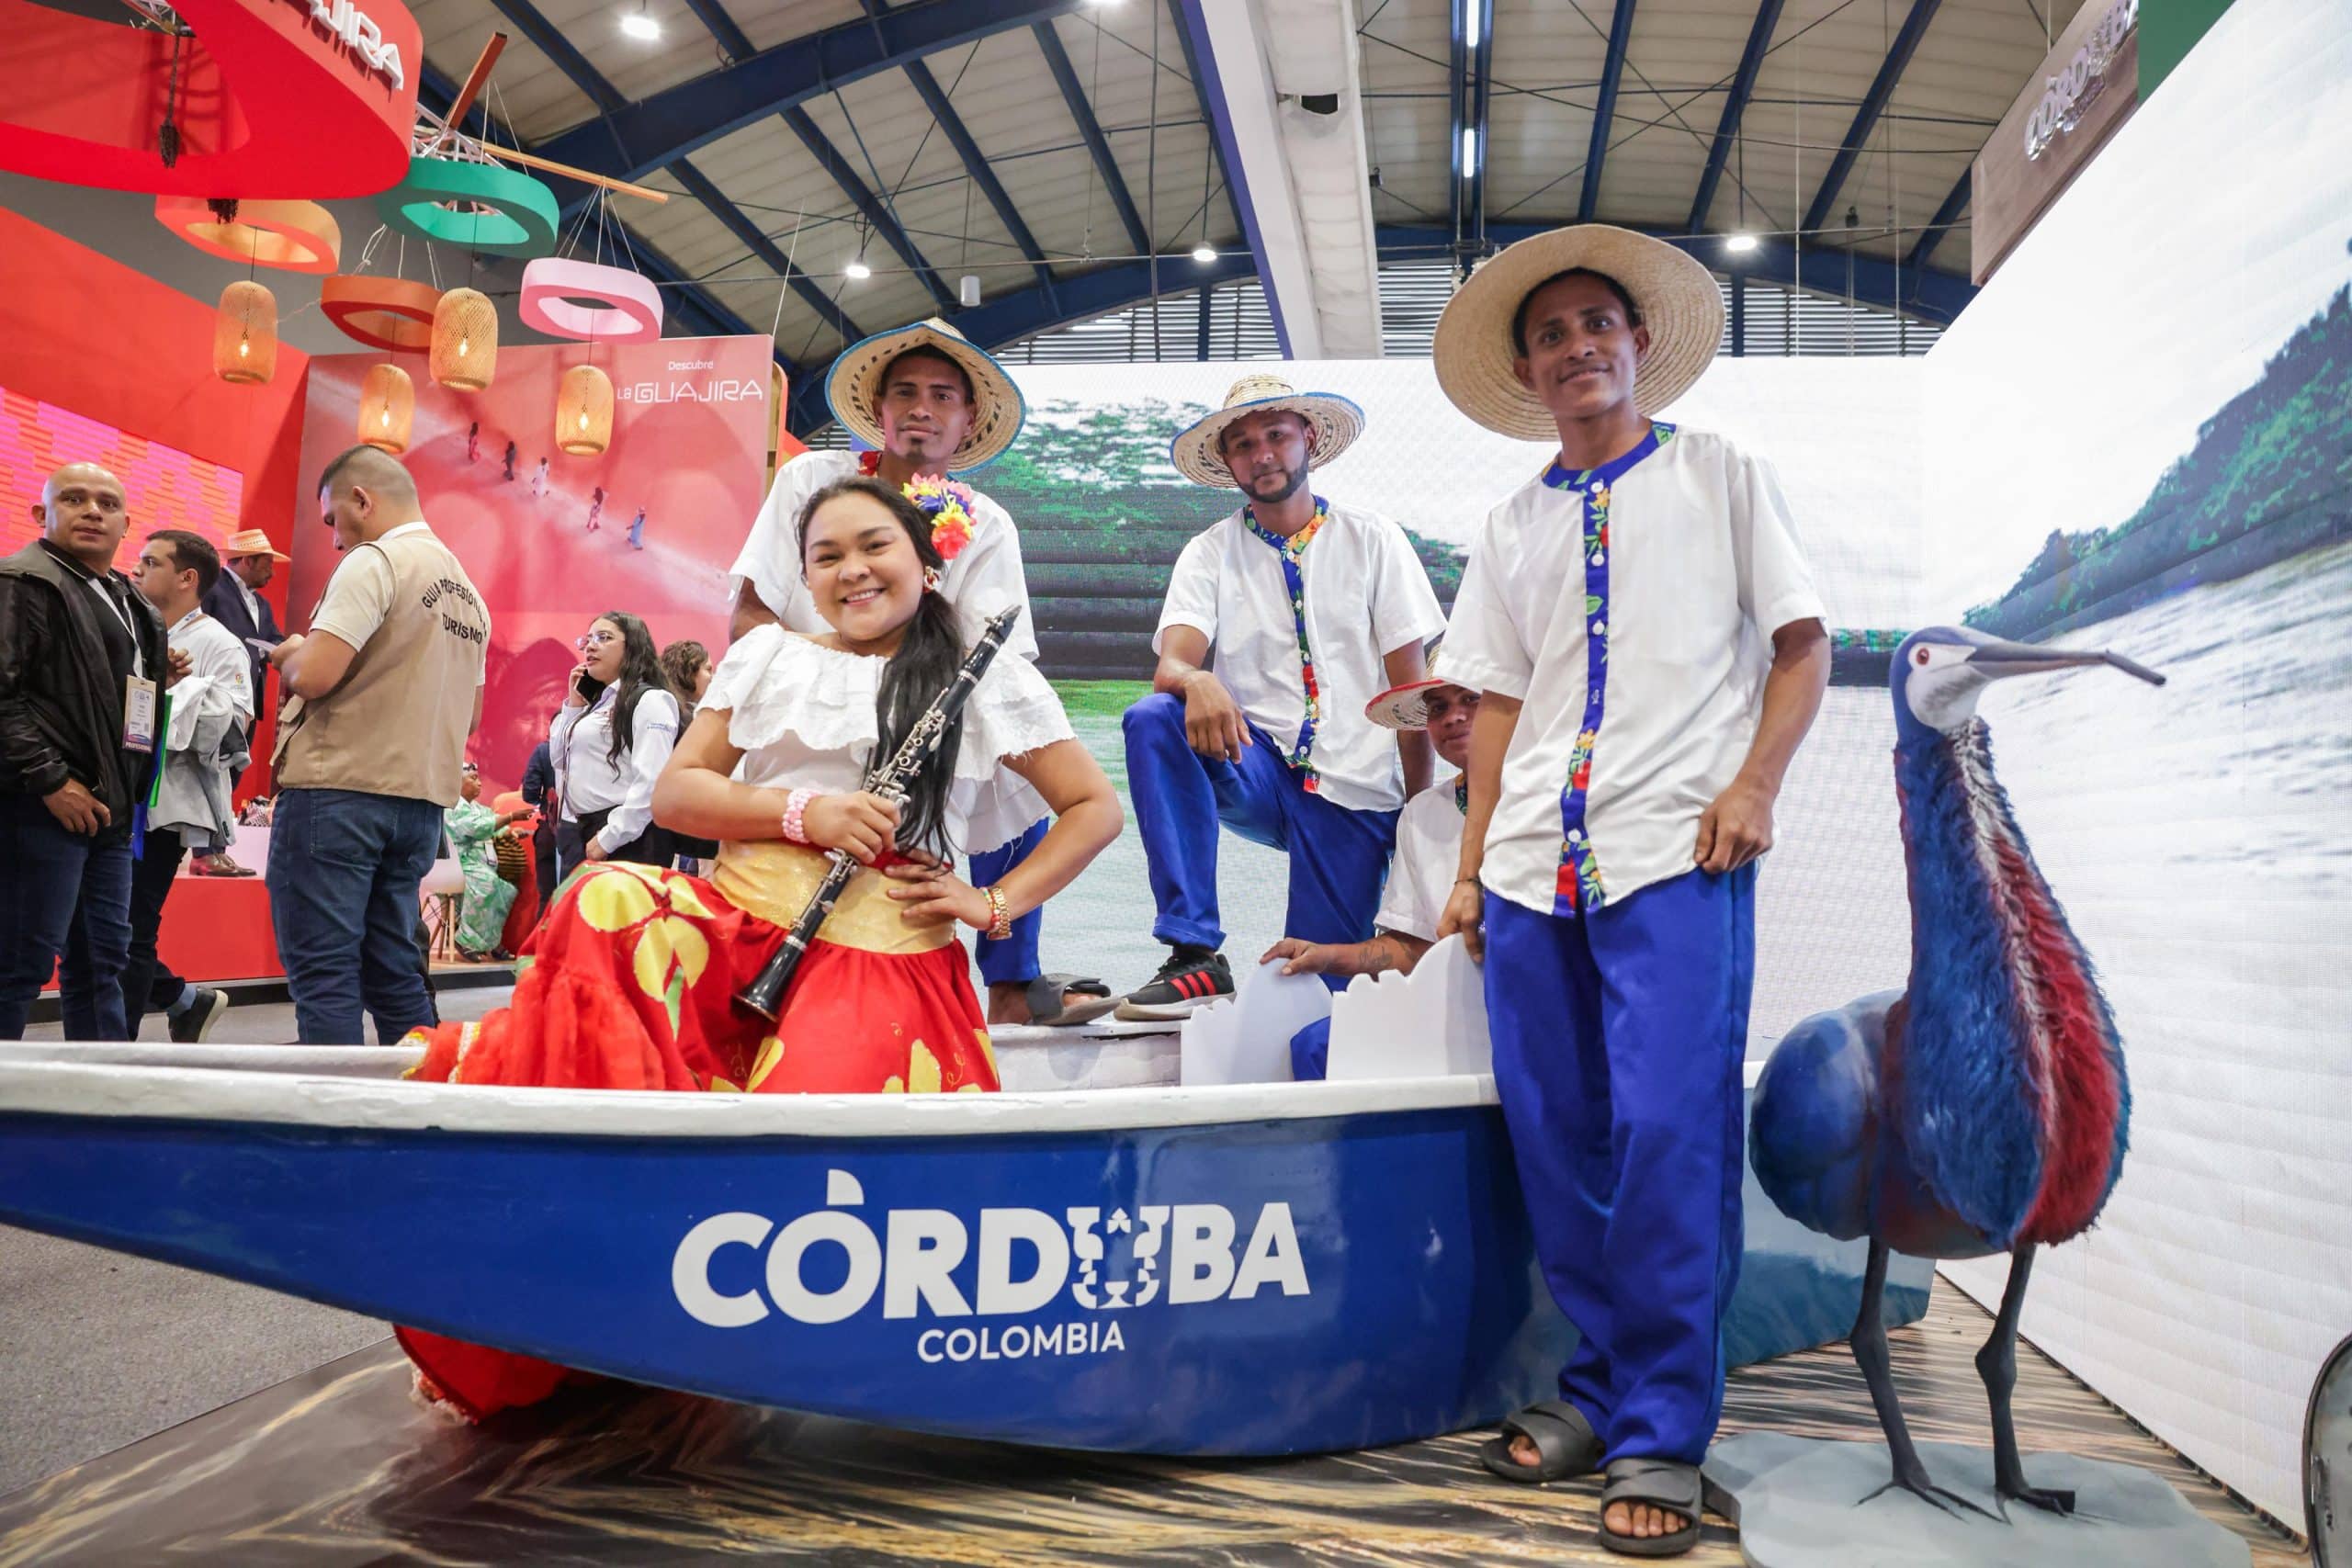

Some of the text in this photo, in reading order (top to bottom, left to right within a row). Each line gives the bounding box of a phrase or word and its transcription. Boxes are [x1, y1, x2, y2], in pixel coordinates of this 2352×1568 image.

[309, 0, 404, 91] JIRA
[668, 359, 714, 371] Descubre
[634, 379, 763, 404] GUAJIRA
[442, 612, 482, 644] TURISMO
[917, 1320, 1125, 1364] COLOMBIA
